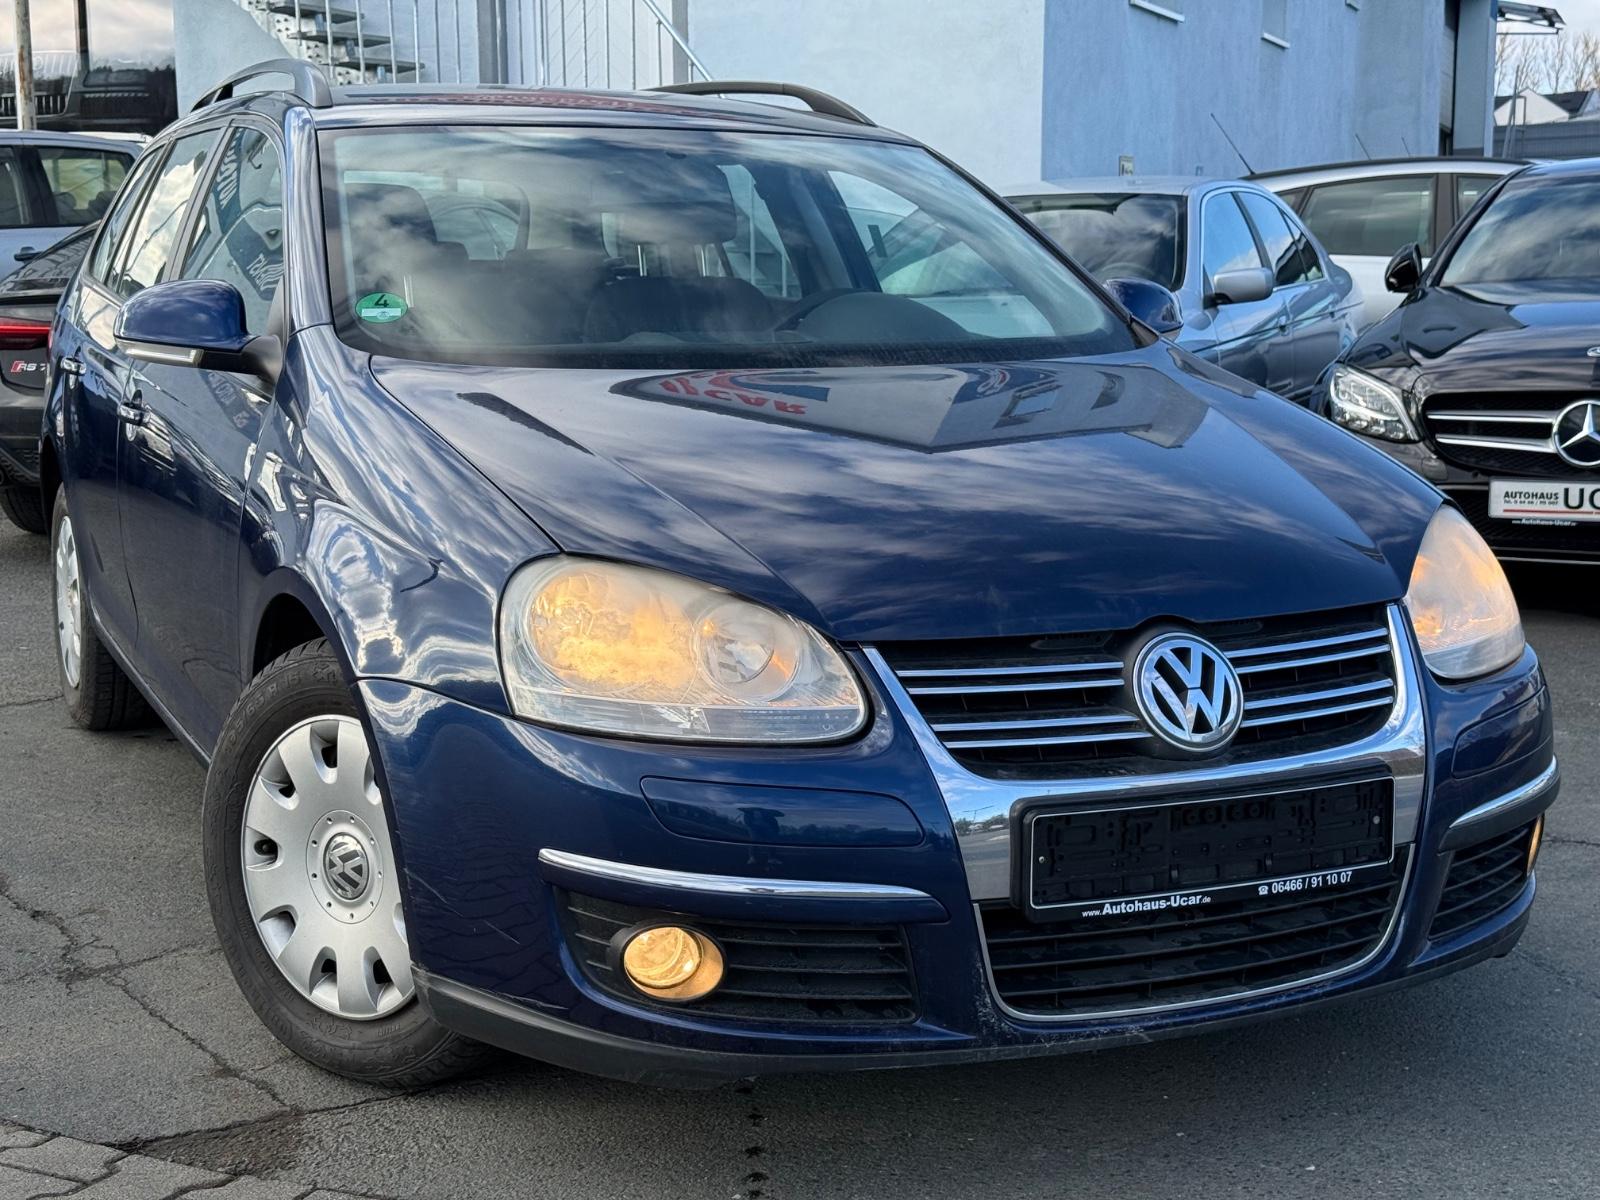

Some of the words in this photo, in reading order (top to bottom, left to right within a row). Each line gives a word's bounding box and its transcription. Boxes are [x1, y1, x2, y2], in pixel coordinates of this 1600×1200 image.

[374, 294, 389, 307] 4
[1503, 491, 1559, 500] AUTOHAUS
[1271, 879, 1303, 894] 06466
[1311, 876, 1323, 888] 91
[1326, 873, 1338, 885] 10
[1340, 871, 1352, 883] 07
[1082, 895, 1211, 917] www.Autohaus-Ucar.de
